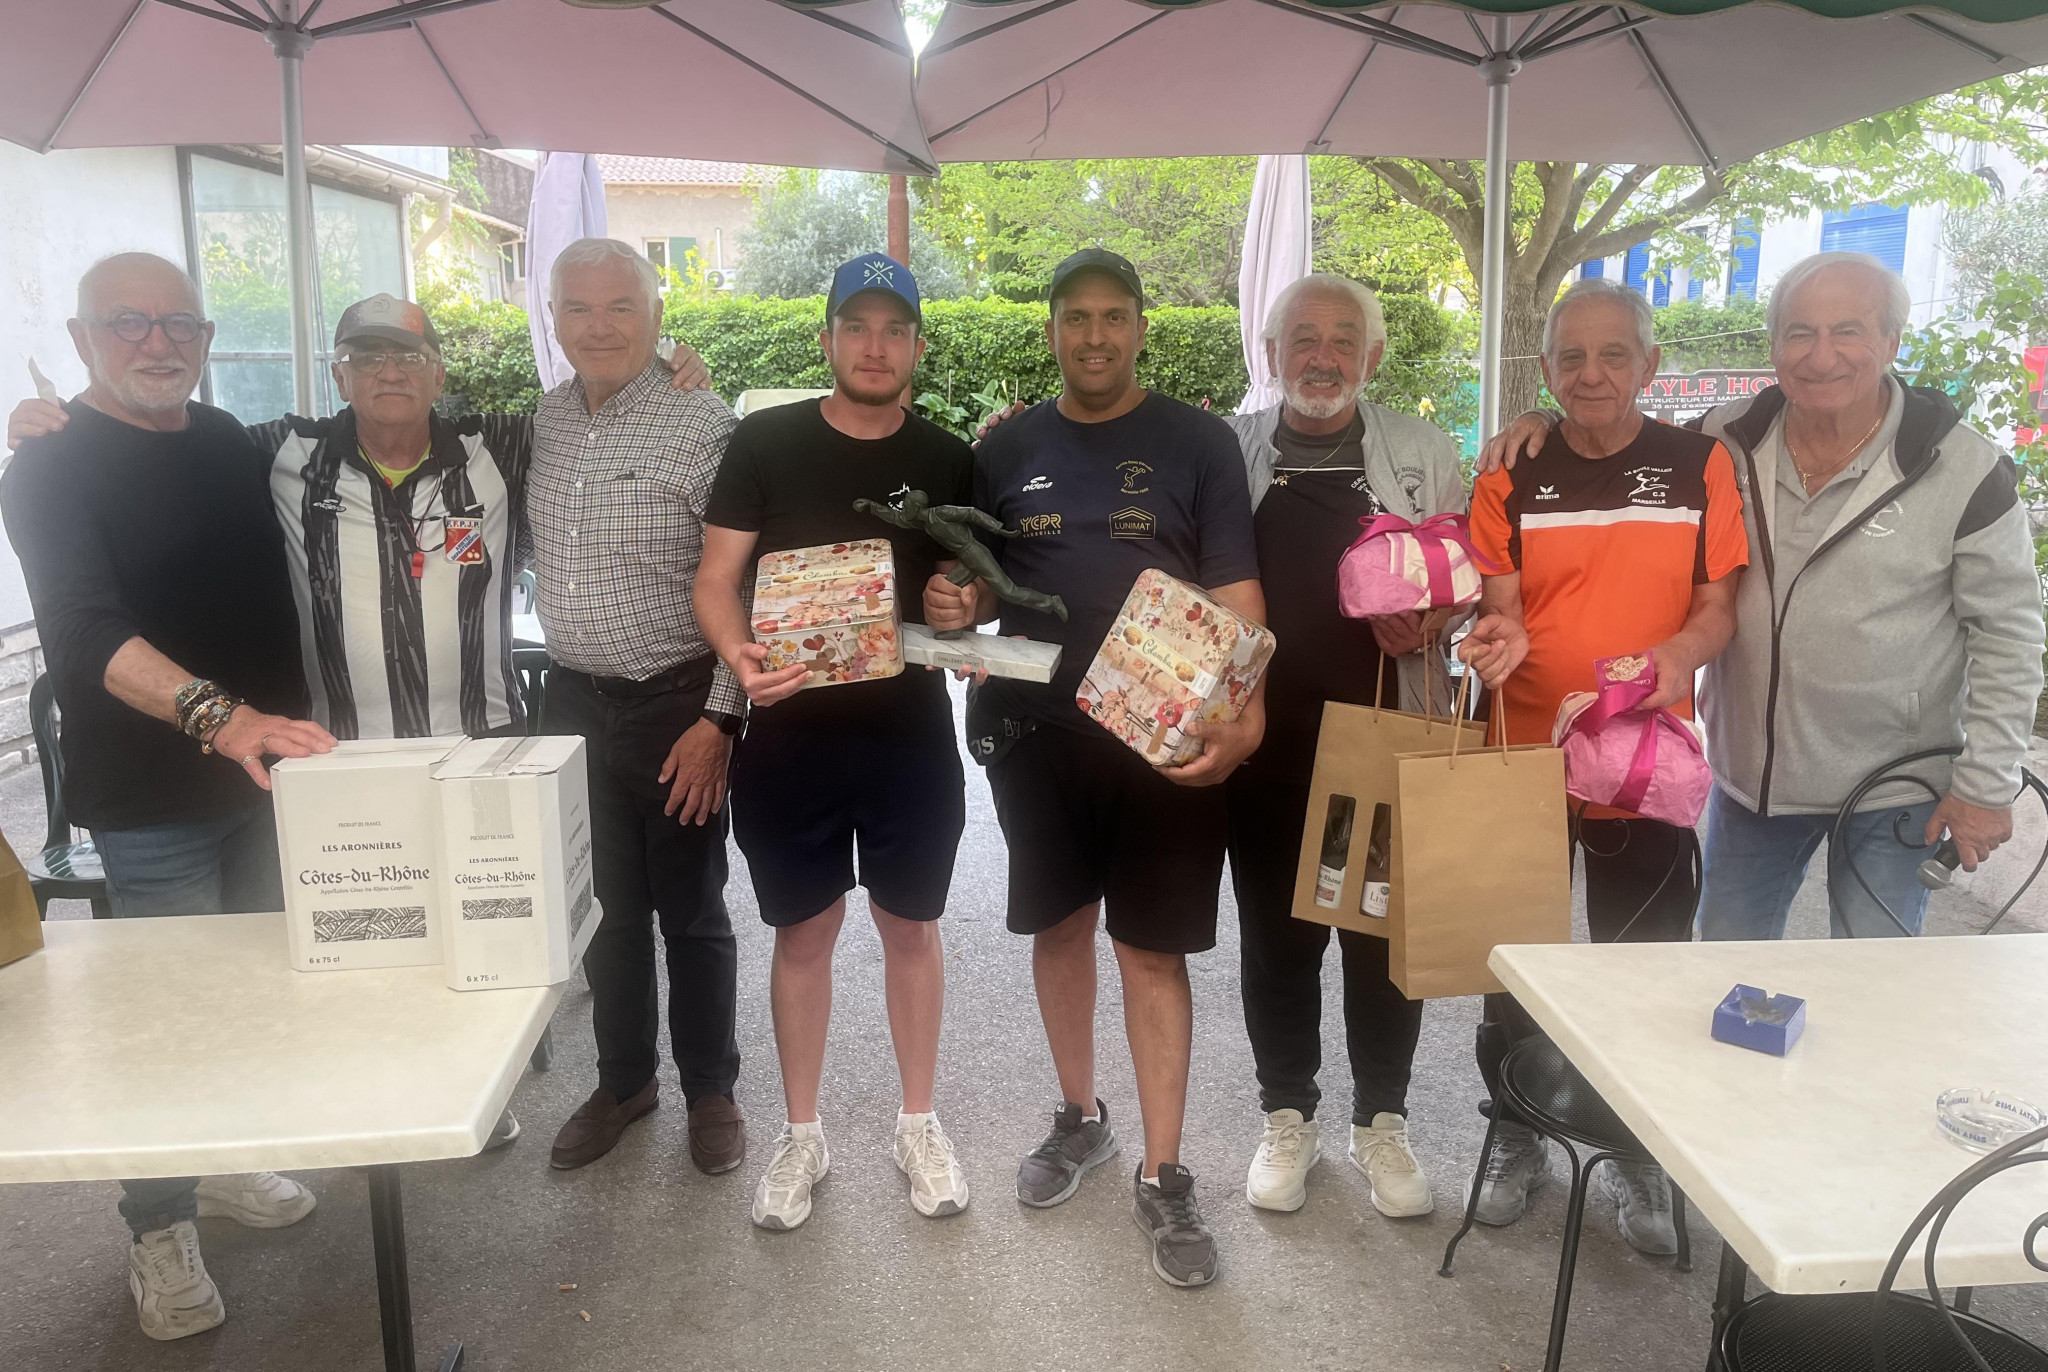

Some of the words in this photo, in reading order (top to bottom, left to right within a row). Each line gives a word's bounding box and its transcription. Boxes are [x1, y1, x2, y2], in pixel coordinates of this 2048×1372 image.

[1642, 378, 1717, 397] TYLE
[1726, 376, 1779, 394] HO
[1114, 521, 1151, 531] LUNIMAT
[322, 844, 339, 852] LES
[340, 840, 402, 852] ARONNIÈRES
[299, 865, 430, 886] Côtes-du-Rhône
[454, 871, 536, 885] Côtes-du-Rhône
[480, 974, 490, 982] 75
